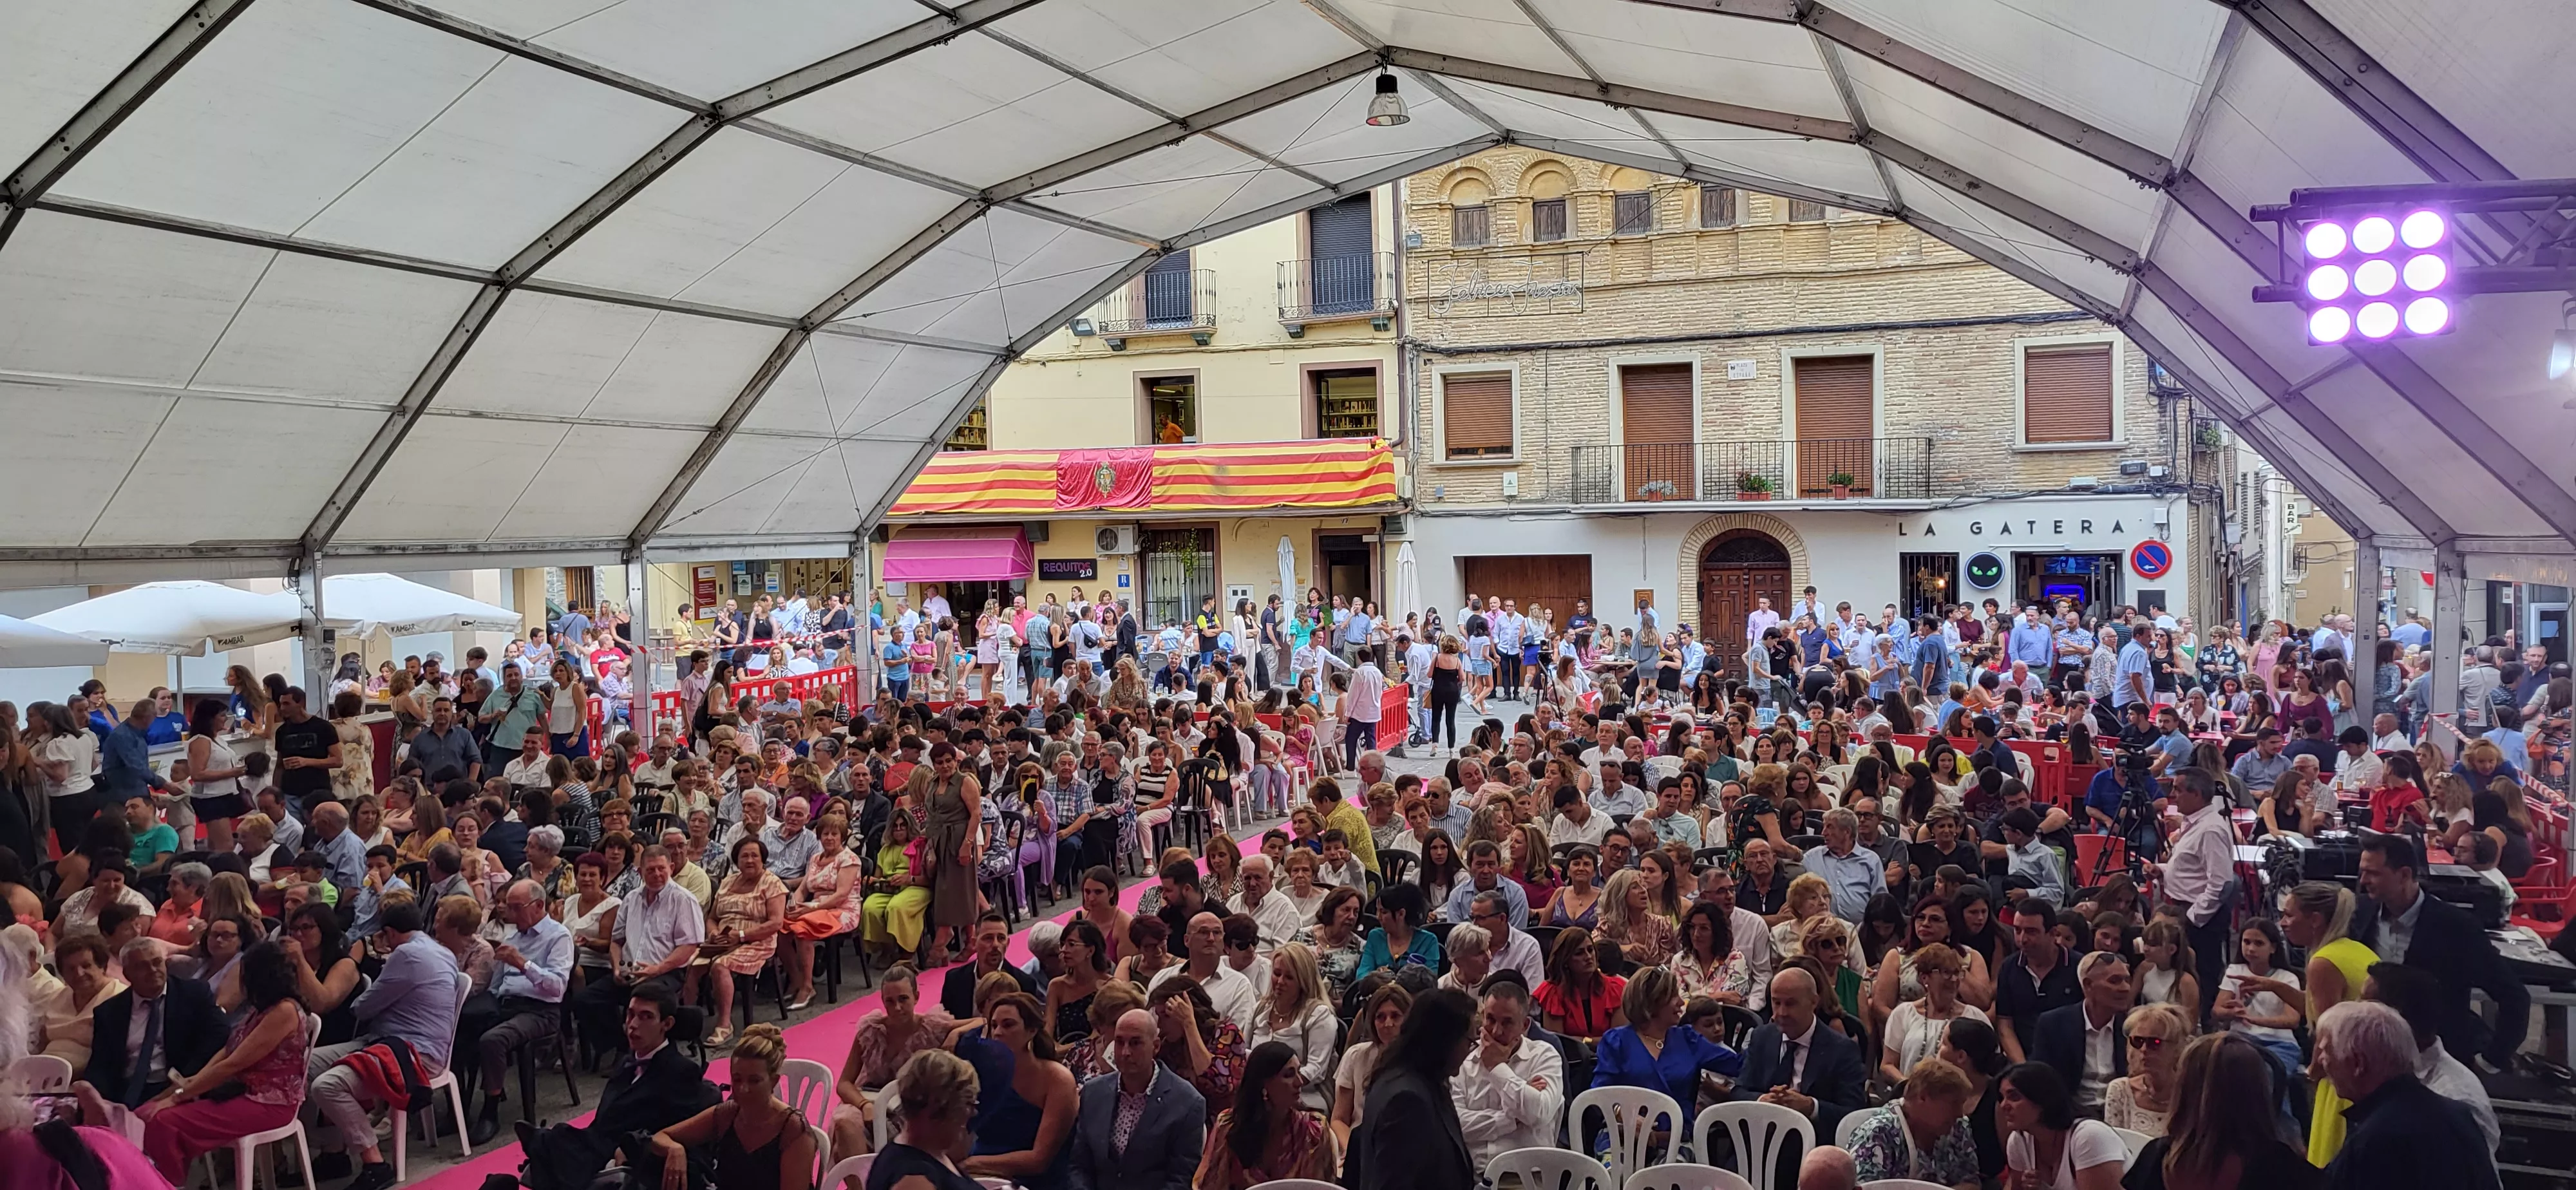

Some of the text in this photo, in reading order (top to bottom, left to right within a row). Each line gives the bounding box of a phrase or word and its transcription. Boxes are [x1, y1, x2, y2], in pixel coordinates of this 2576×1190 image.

[1899, 520, 2125, 536] LA GATERA
[1043, 562, 1091, 572] REQUITOS
[1079, 569, 1092, 578] 2.0
[1121, 575, 1127, 583] R
[395, 623, 416, 632] AMBAR
[221, 635, 245, 645] AMBAR
